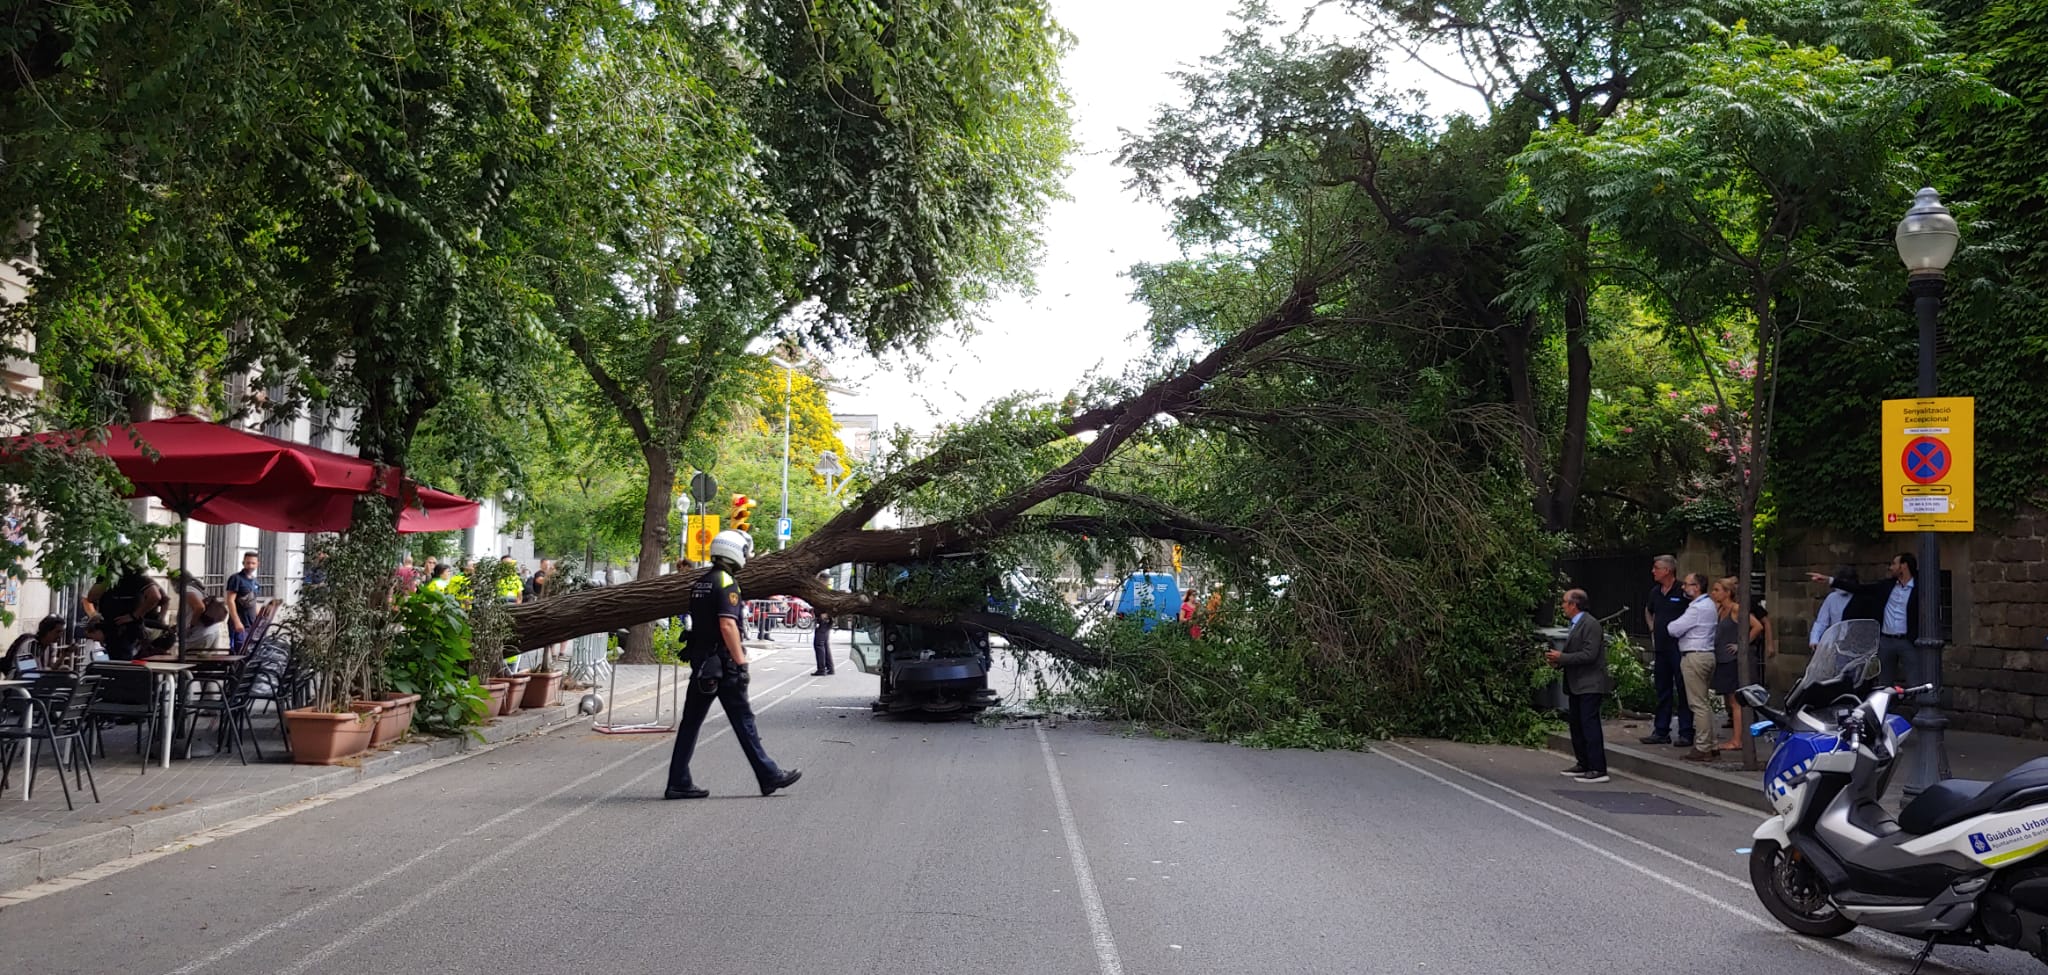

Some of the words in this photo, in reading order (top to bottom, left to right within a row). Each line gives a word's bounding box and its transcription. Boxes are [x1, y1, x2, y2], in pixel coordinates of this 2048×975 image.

[1903, 406, 1951, 416] Senyalització
[1904, 415, 1949, 424] Excepcional
[781, 520, 789, 534] P
[1986, 827, 2021, 841] Guàrdia
